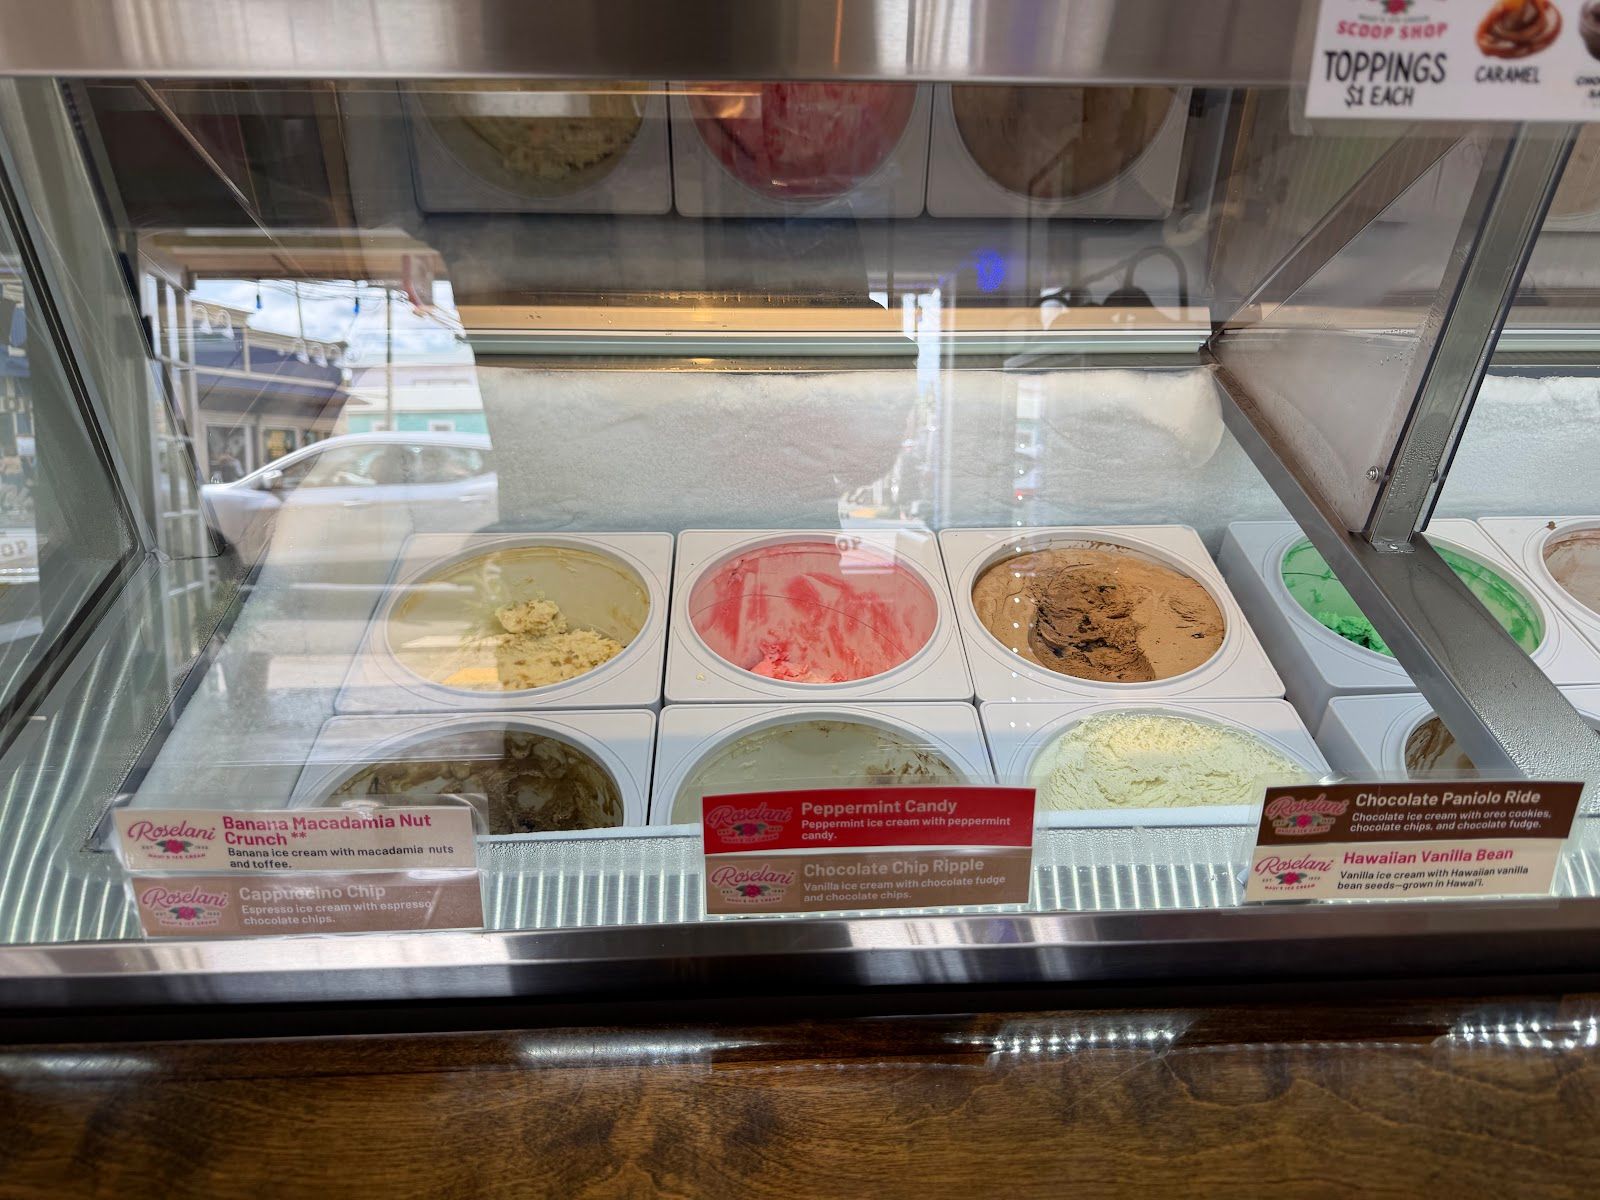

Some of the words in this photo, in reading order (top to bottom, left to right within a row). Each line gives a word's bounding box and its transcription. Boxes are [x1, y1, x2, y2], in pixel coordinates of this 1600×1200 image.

[1336, 20, 1394, 39] SCOOP
[1400, 22, 1448, 40] SHOP
[1324, 50, 1447, 84] TOPPINGS
[1475, 65, 1540, 84] CARAMEL
[1345, 85, 1364, 107] $1
[1370, 86, 1415, 106] EACH
[1265, 794, 1350, 819] Roselani
[1356, 793, 1438, 807] Chocolate
[1442, 791, 1501, 805] Paniolo
[1504, 790, 1541, 804] Ride
[706, 802, 792, 828] Roselani
[801, 800, 900, 818] Peppermint
[905, 800, 957, 814] Candy
[1352, 812, 1404, 822] Chocolate
[1407, 812, 1422, 820] ice
[1424, 812, 1457, 820] cream
[1460, 811, 1481, 820] with
[1484, 810, 1506, 818] oreo
[222, 816, 288, 830] Banana
[292, 815, 395, 830] Macadamia
[400, 814, 432, 827] Nut
[802, 819, 864, 830] Peppermint
[867, 819, 884, 827] ice
[886, 818, 920, 826] cream
[922, 817, 946, 826] with
[948, 816, 1011, 827] peppermint
[1350, 822, 1401, 832] chocolate
[1436, 822, 1455, 830] and
[1457, 820, 1507, 830] chocolate
[1510, 820, 1542, 830] fudge.
[128, 820, 216, 842] Roselani
[225, 832, 288, 846] Crunch
[802, 831, 838, 840] candy.
[228, 848, 269, 857] Banana
[272, 848, 288, 856] ice
[330, 848, 354, 856] with
[358, 845, 424, 856] macadamia
[429, 846, 454, 854] nuts
[1344, 852, 1416, 864] Hawaiian
[1422, 850, 1472, 862] Vanilla
[1476, 849, 1514, 860] Bean
[230, 860, 250, 868] and
[253, 860, 292, 868] toffee.
[804, 862, 888, 877] Chocolate
[892, 860, 929, 876] Chip
[933, 858, 984, 874] Ripple
[1254, 854, 1334, 876] Roselani
[711, 864, 795, 886] Roselani
[1340, 871, 1374, 880] Vanilla
[1376, 871, 1392, 879] ice
[1428, 869, 1448, 878] with
[1450, 868, 1494, 877] Hawaiian
[1498, 866, 1528, 874] vanilla
[804, 882, 839, 892] Vanilla
[842, 881, 858, 890] ice
[860, 882, 893, 890] cream
[896, 880, 918, 888] with
[921, 878, 973, 888] chocolate
[976, 876, 1006, 886] fudge
[1337, 882, 1362, 890] bean
[1434, 880, 1444, 888] in
[142, 887, 228, 908] Roselani
[239, 886, 342, 903] Cappuccino
[347, 884, 386, 900] Chip
[804, 894, 824, 902] and
[826, 891, 878, 900] chocolate
[880, 890, 912, 900] chips.
[242, 904, 293, 916] Espresso
[296, 904, 312, 912] ice
[315, 904, 350, 912] cream
[353, 901, 378, 910] with
[380, 900, 432, 911] espresso
[244, 916, 299, 925] chocolate
[302, 915, 336, 925] chips.
